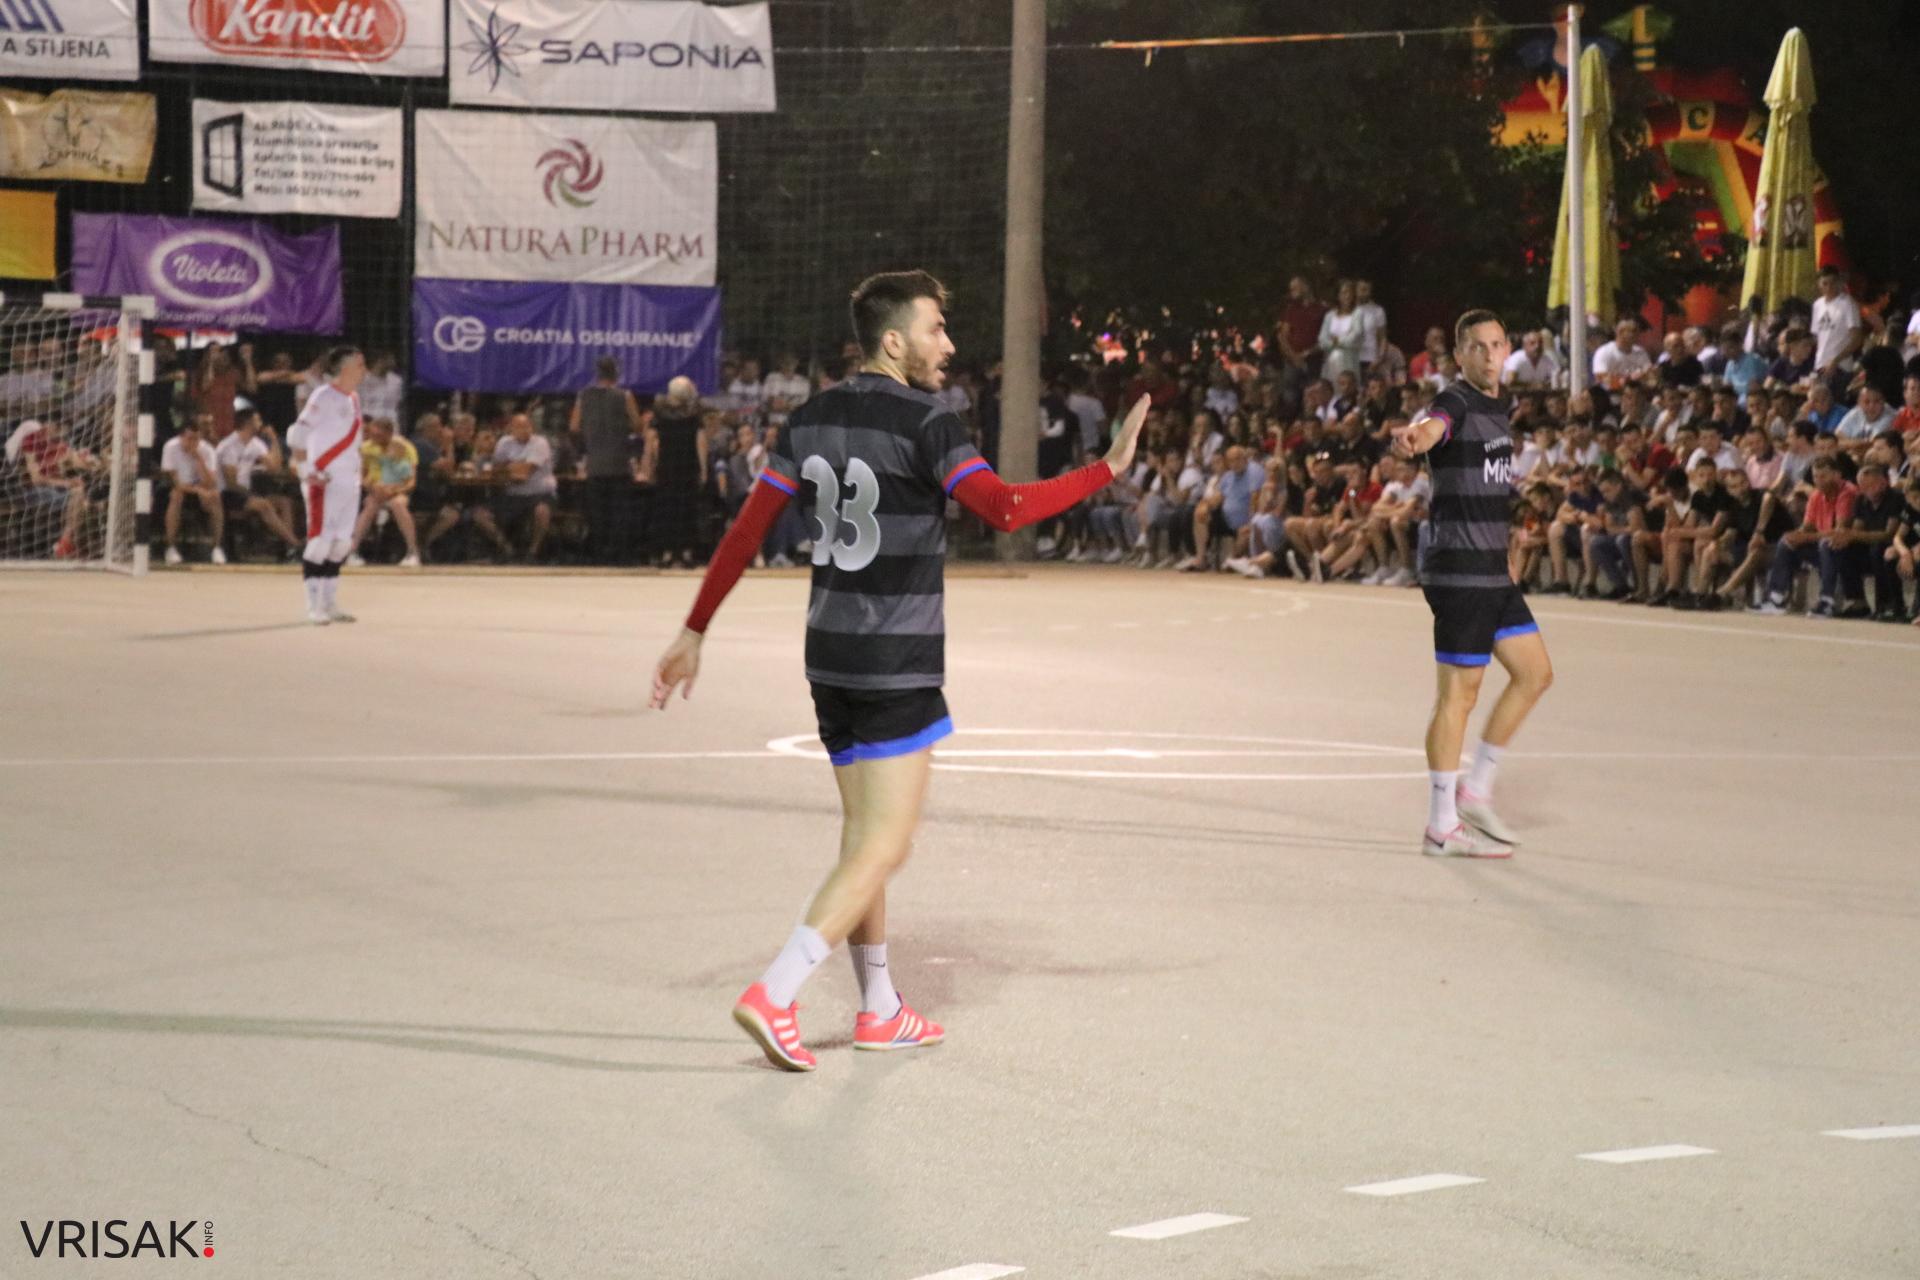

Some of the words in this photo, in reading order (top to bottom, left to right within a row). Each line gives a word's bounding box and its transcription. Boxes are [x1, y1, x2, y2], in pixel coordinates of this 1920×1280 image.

[219, 0, 376, 43] Kandit
[25, 38, 110, 59] STIJENA
[427, 221, 573, 261] NATURA
[581, 226, 704, 265] PHARM
[173, 253, 249, 284] Violeta
[493, 327, 575, 346] CROATIA
[578, 329, 696, 349] OSIGURANJE
[801, 454, 881, 572] 33
